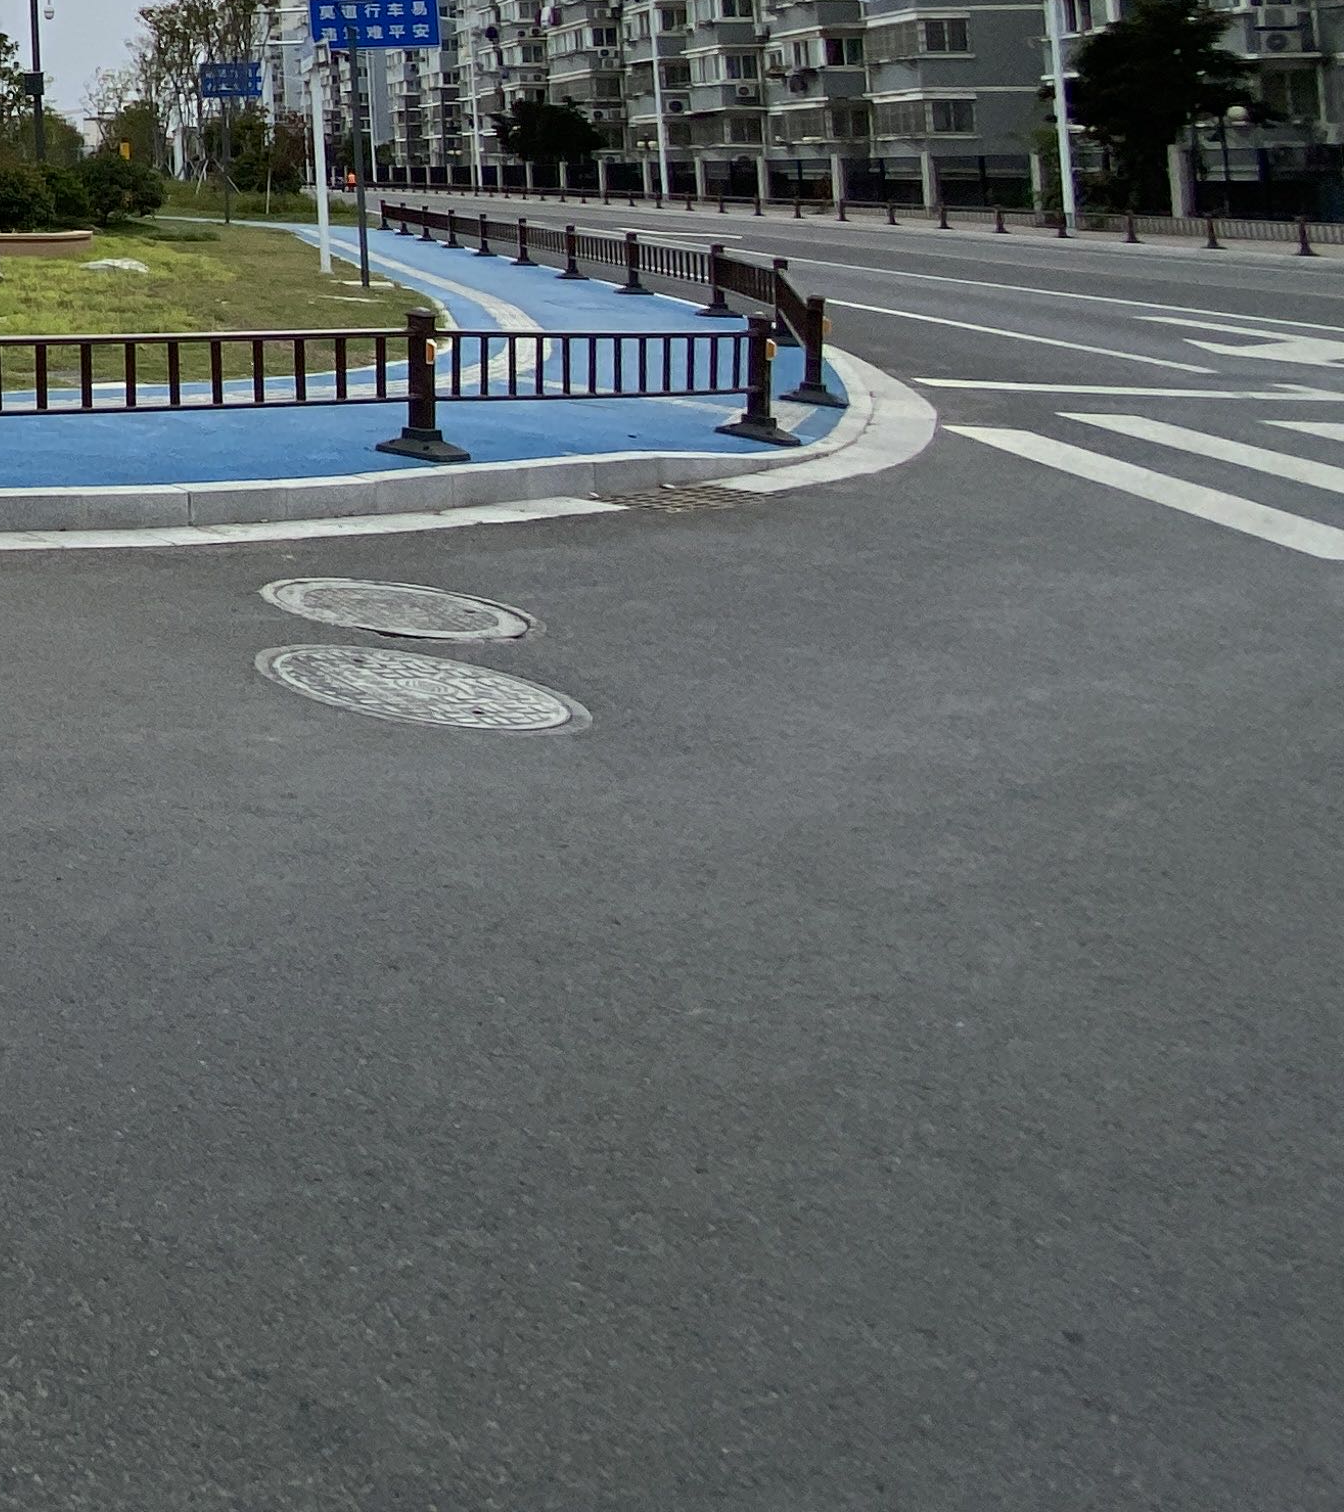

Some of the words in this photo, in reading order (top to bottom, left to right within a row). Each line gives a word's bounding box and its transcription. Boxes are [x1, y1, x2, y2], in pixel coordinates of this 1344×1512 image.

[319, 1, 428, 20] 莫道行车易
